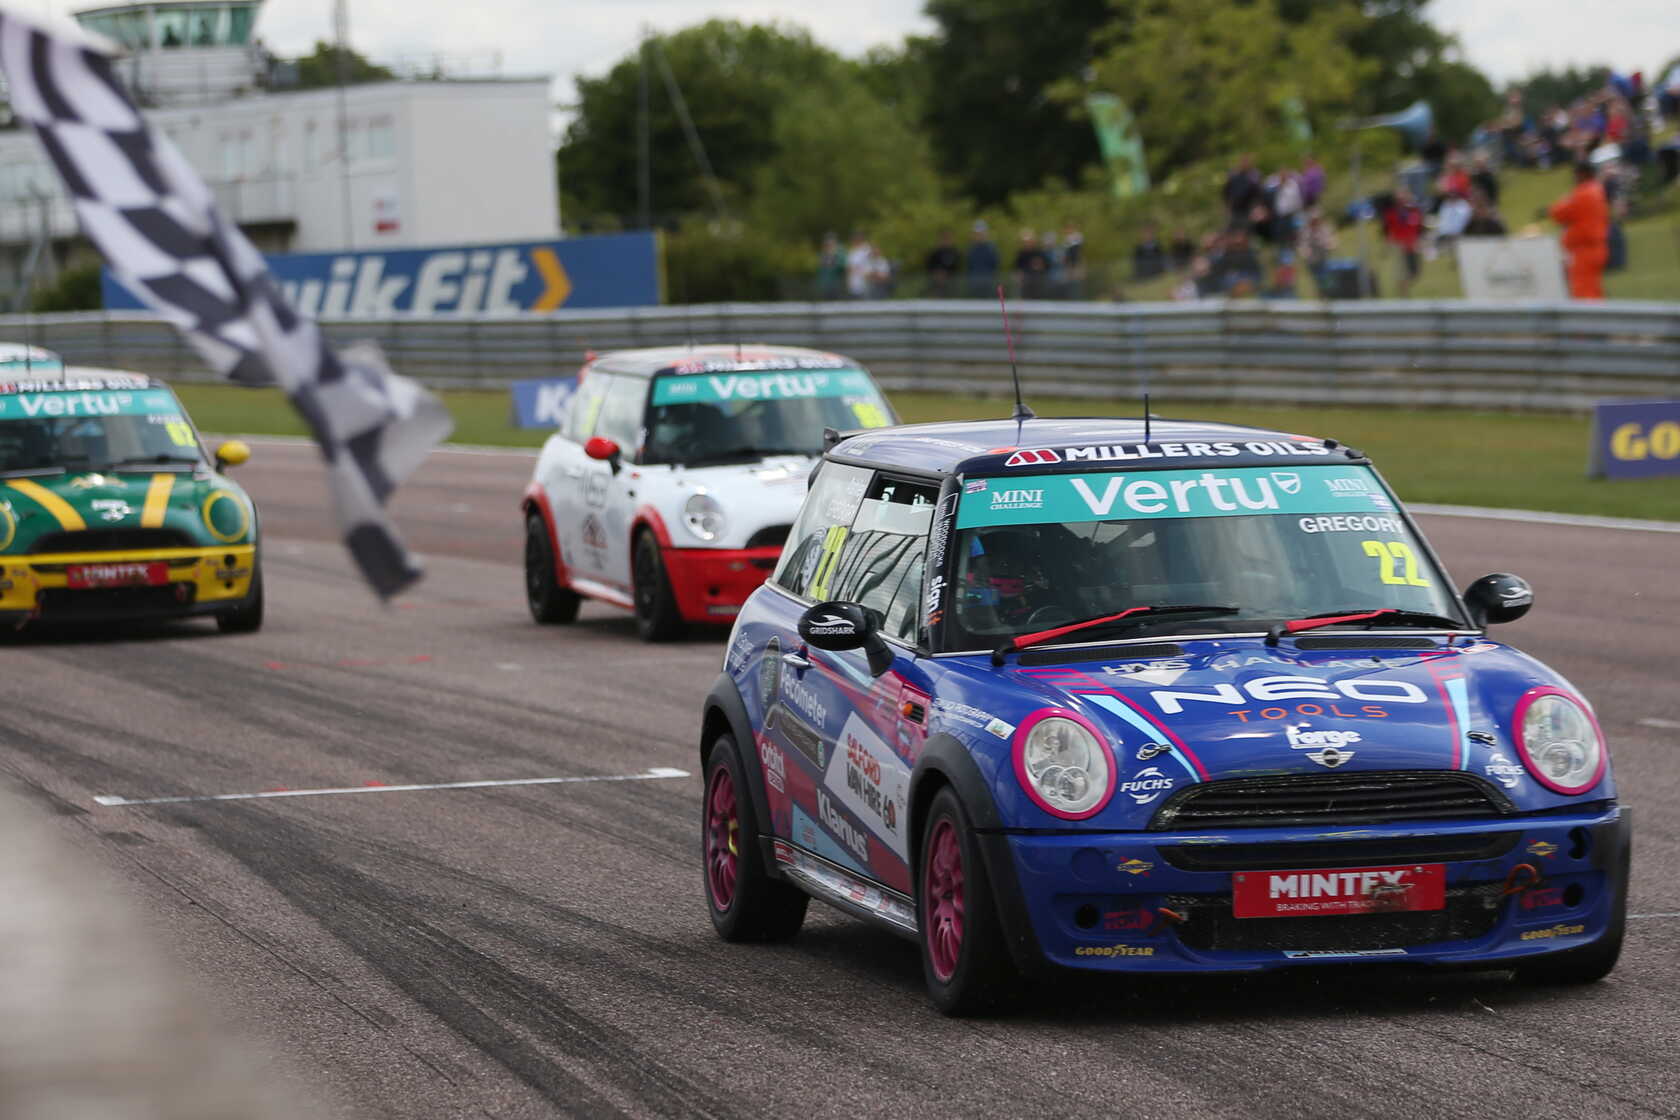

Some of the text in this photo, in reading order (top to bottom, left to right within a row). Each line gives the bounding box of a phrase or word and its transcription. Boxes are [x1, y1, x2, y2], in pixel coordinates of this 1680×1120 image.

[708, 373, 817, 399] Vertu
[17, 391, 121, 416] Vertu
[1066, 441, 1329, 461] MILLERS OILS
[991, 489, 1044, 505] MINI
[1069, 473, 1280, 516] Vertu
[1298, 516, 1406, 534] GREGORY
[1361, 540, 1429, 587] 22
[809, 626, 856, 635] GRIDSHARK
[1210, 654, 1402, 671] HAULAGE
[1149, 675, 1429, 715] NEO
[1226, 703, 1392, 724] TOOLS
[1120, 778, 1174, 793] FUCHS
[1269, 870, 1407, 899] MINTEX
[1276, 903, 1320, 912] BRAKING
[1075, 944, 1155, 957] GOODYEAR
